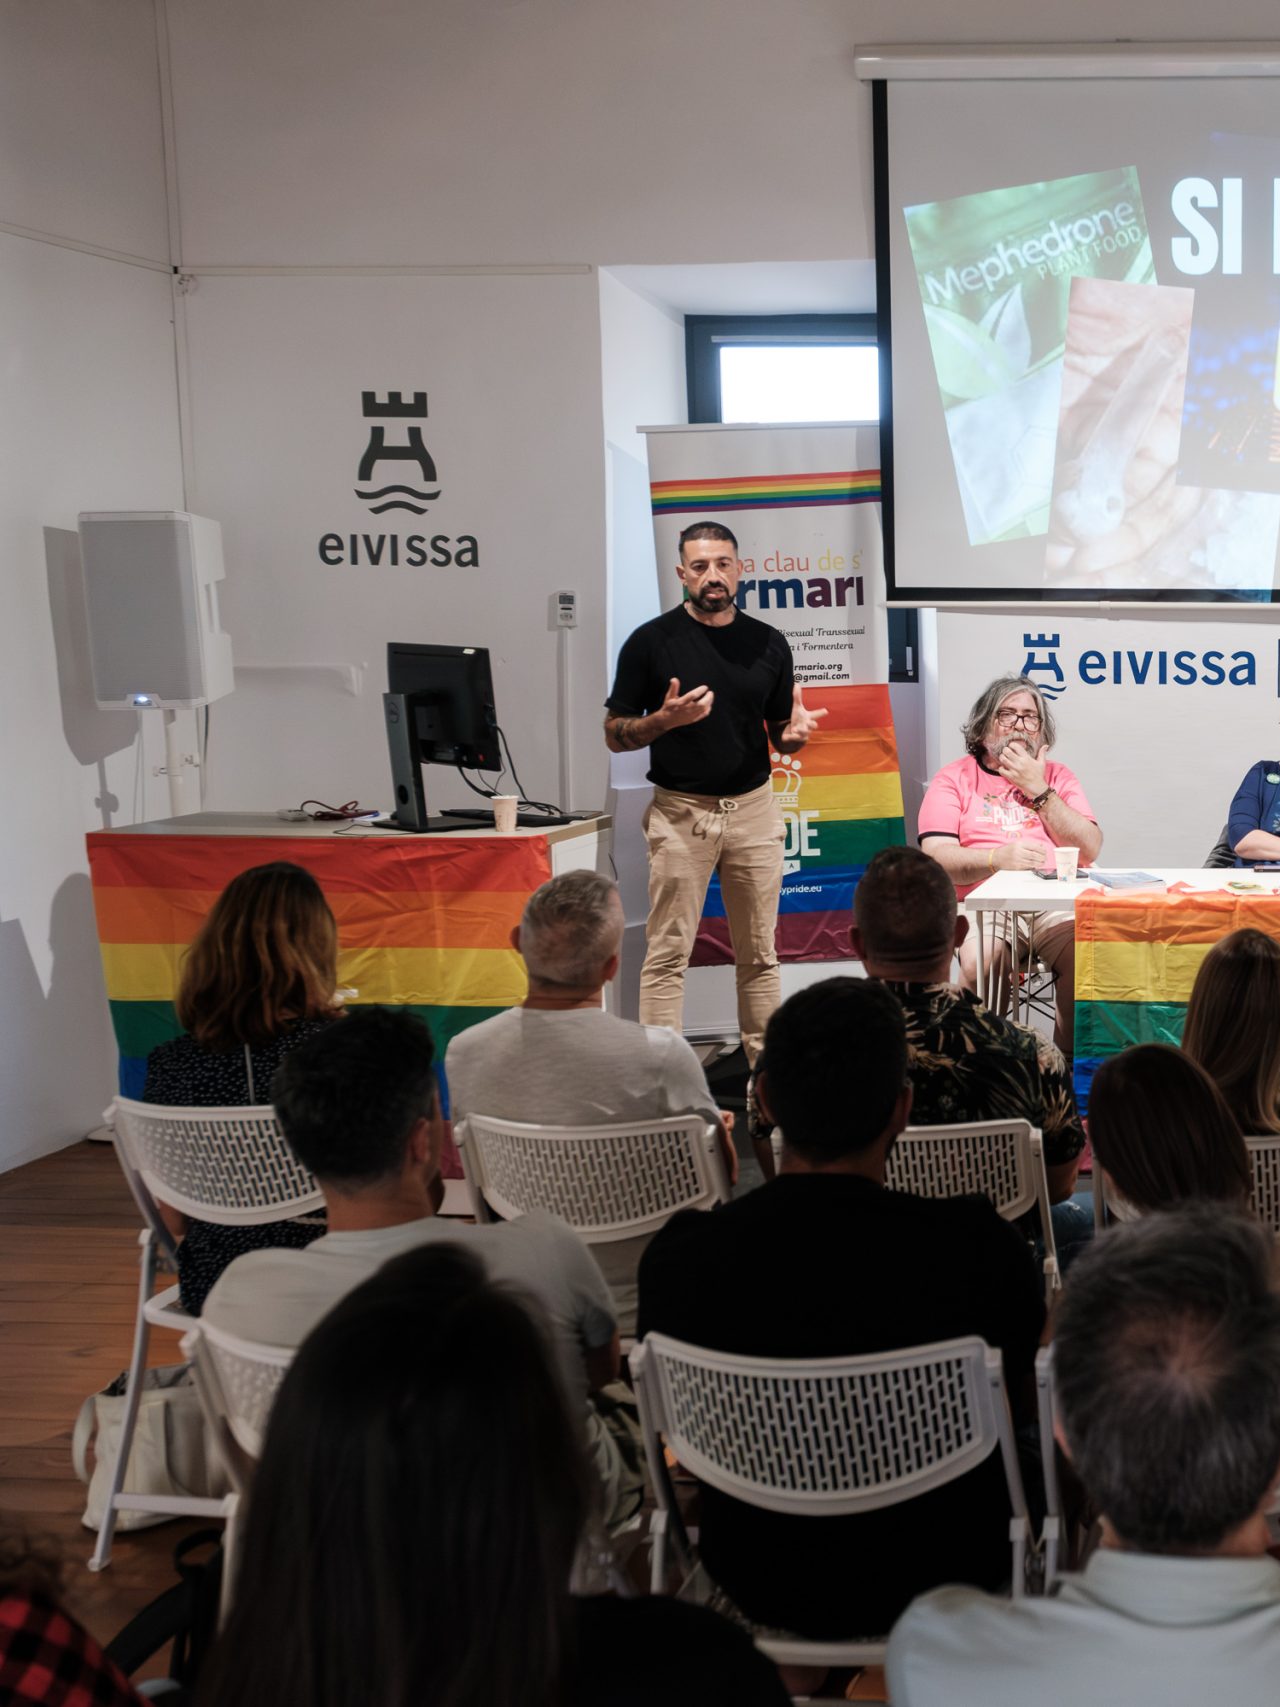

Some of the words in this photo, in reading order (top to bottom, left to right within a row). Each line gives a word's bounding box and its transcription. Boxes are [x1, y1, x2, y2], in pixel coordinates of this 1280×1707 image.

[1170, 177, 1242, 275] SI
[924, 202, 1136, 305] Mephedrone
[1038, 247, 1090, 280] PLANT
[1092, 226, 1142, 258] FOOD
[318, 533, 479, 567] eivissa
[763, 550, 809, 573] clau
[817, 547, 845, 571] de
[801, 642, 854, 651] Formentera
[815, 626, 865, 637] Transsexual
[1079, 650, 1256, 687] eivissa
